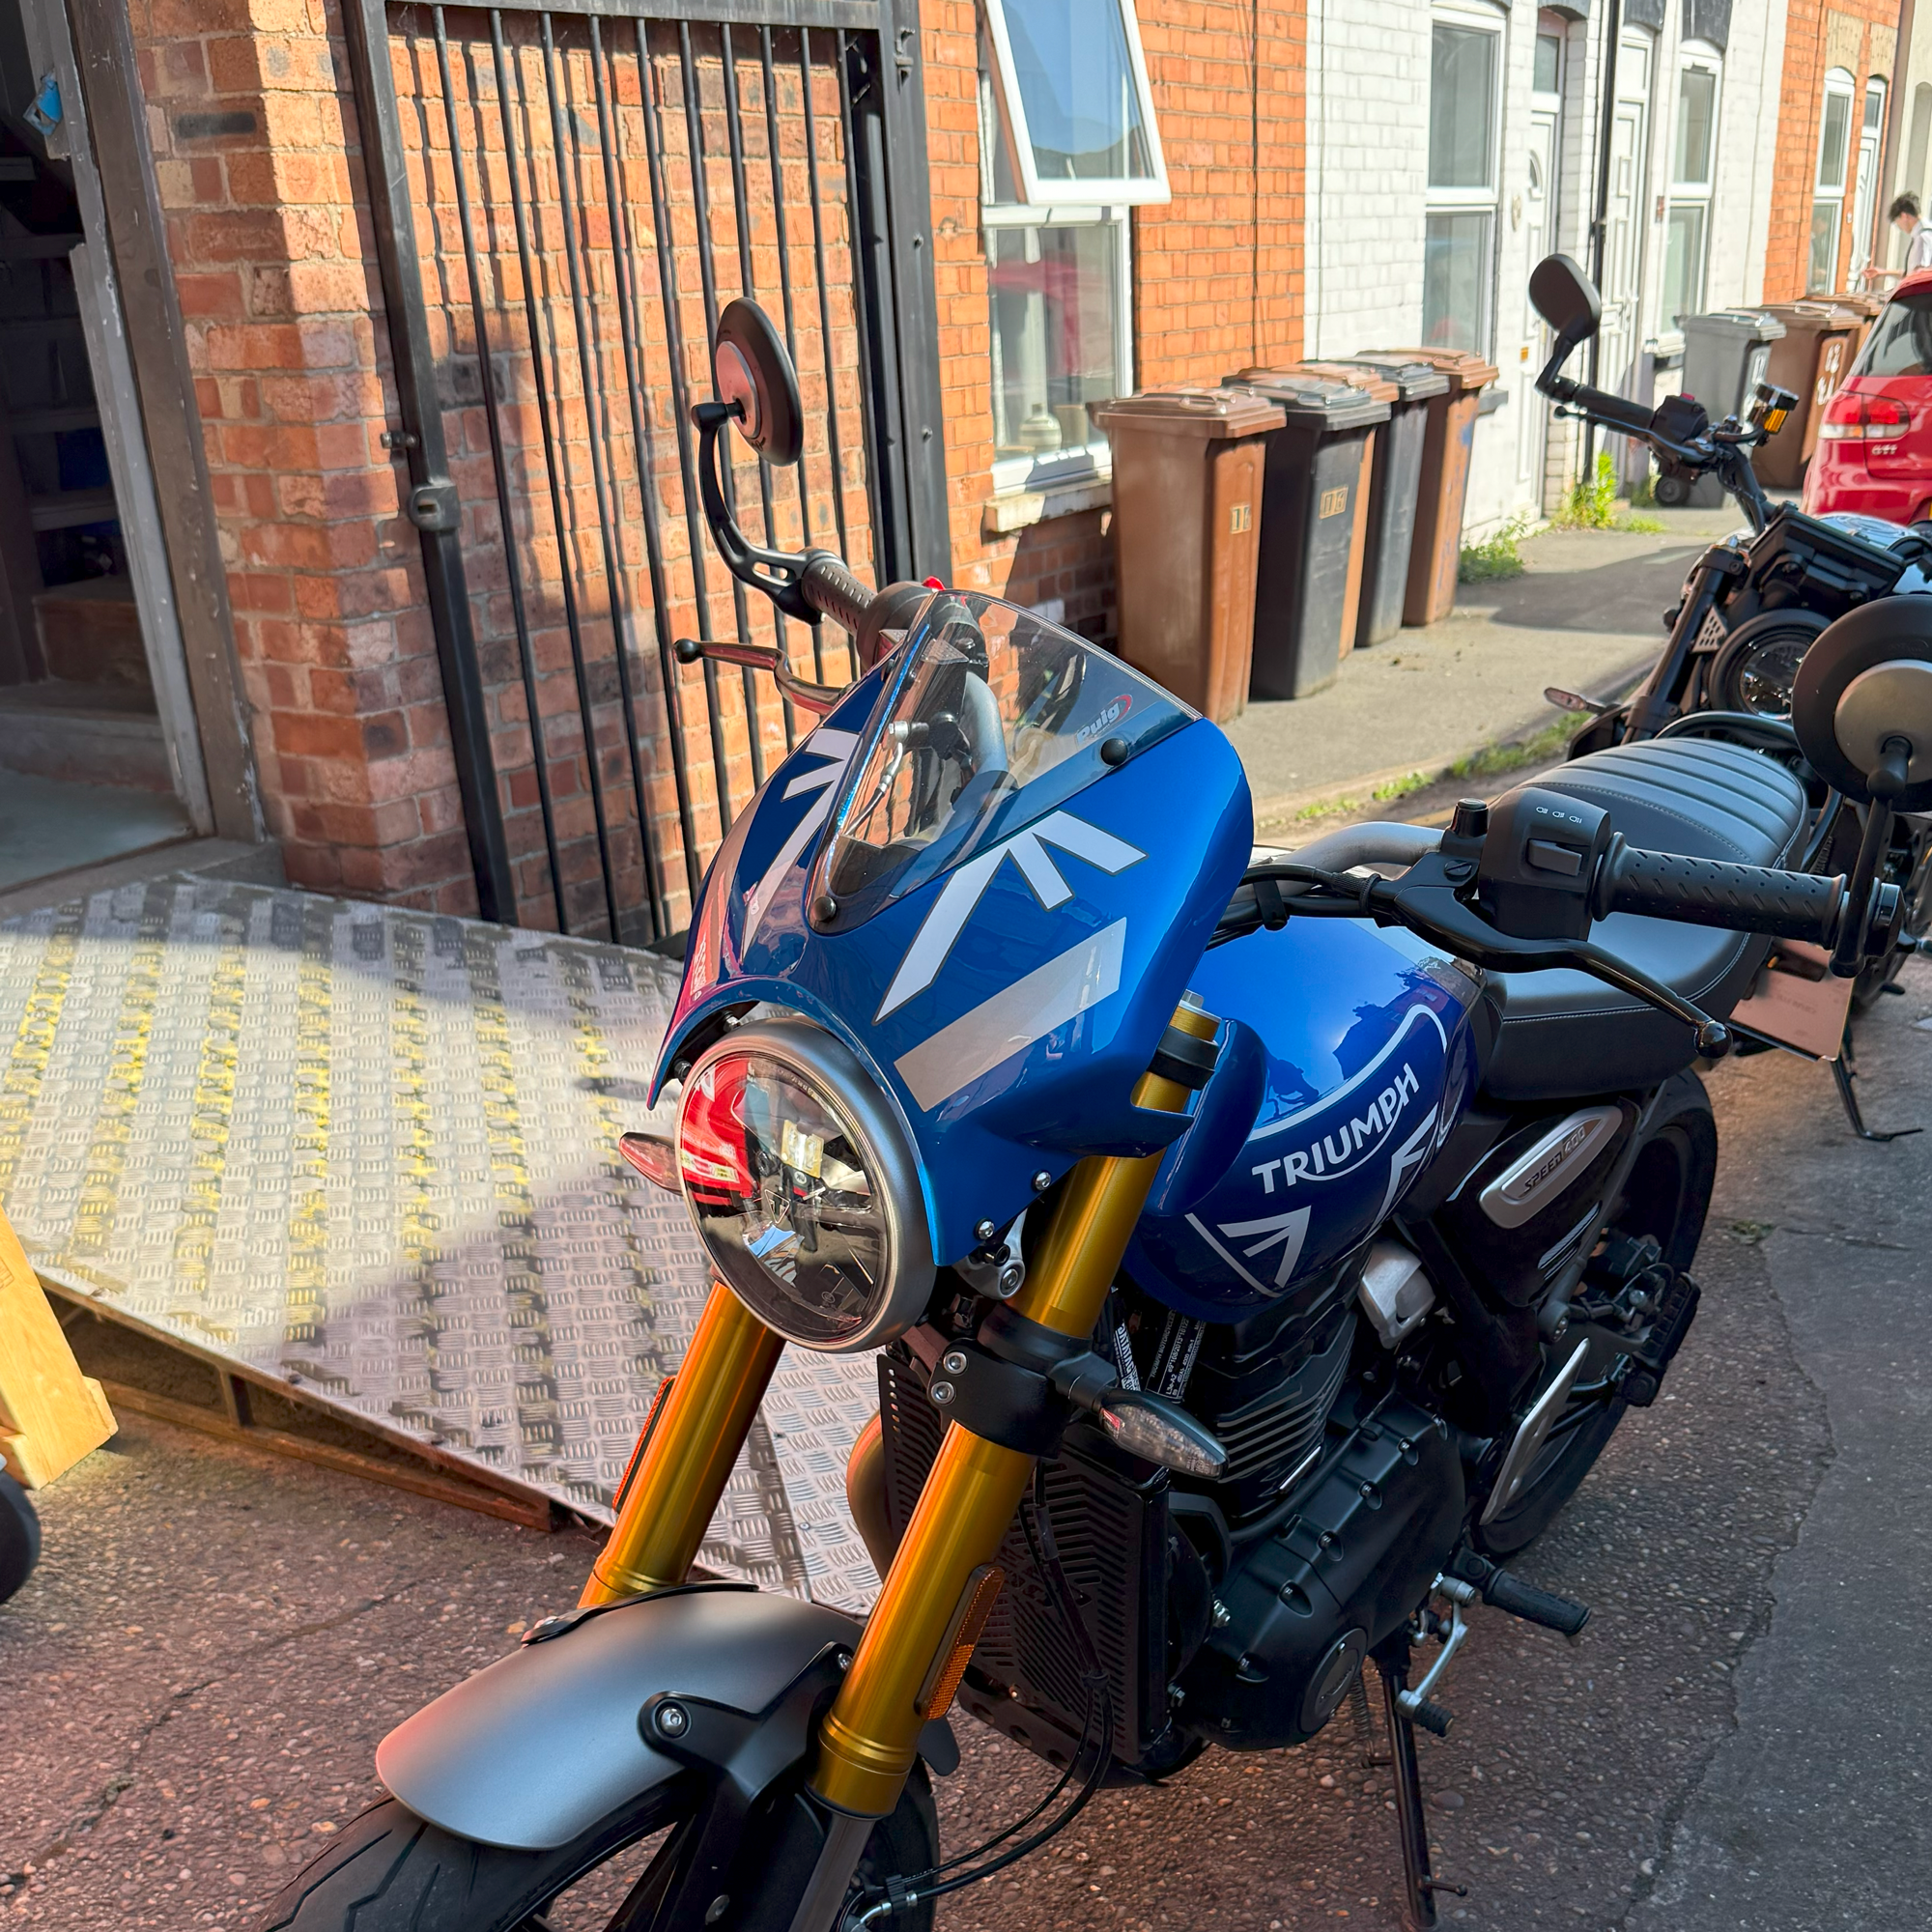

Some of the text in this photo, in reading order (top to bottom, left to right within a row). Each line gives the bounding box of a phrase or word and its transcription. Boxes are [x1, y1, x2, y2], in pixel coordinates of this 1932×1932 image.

[1077, 702, 1120, 747] Puig
[1252, 1063, 1419, 1194] TRIUMPH
[1524, 1125, 1585, 1192] SPEED 400
